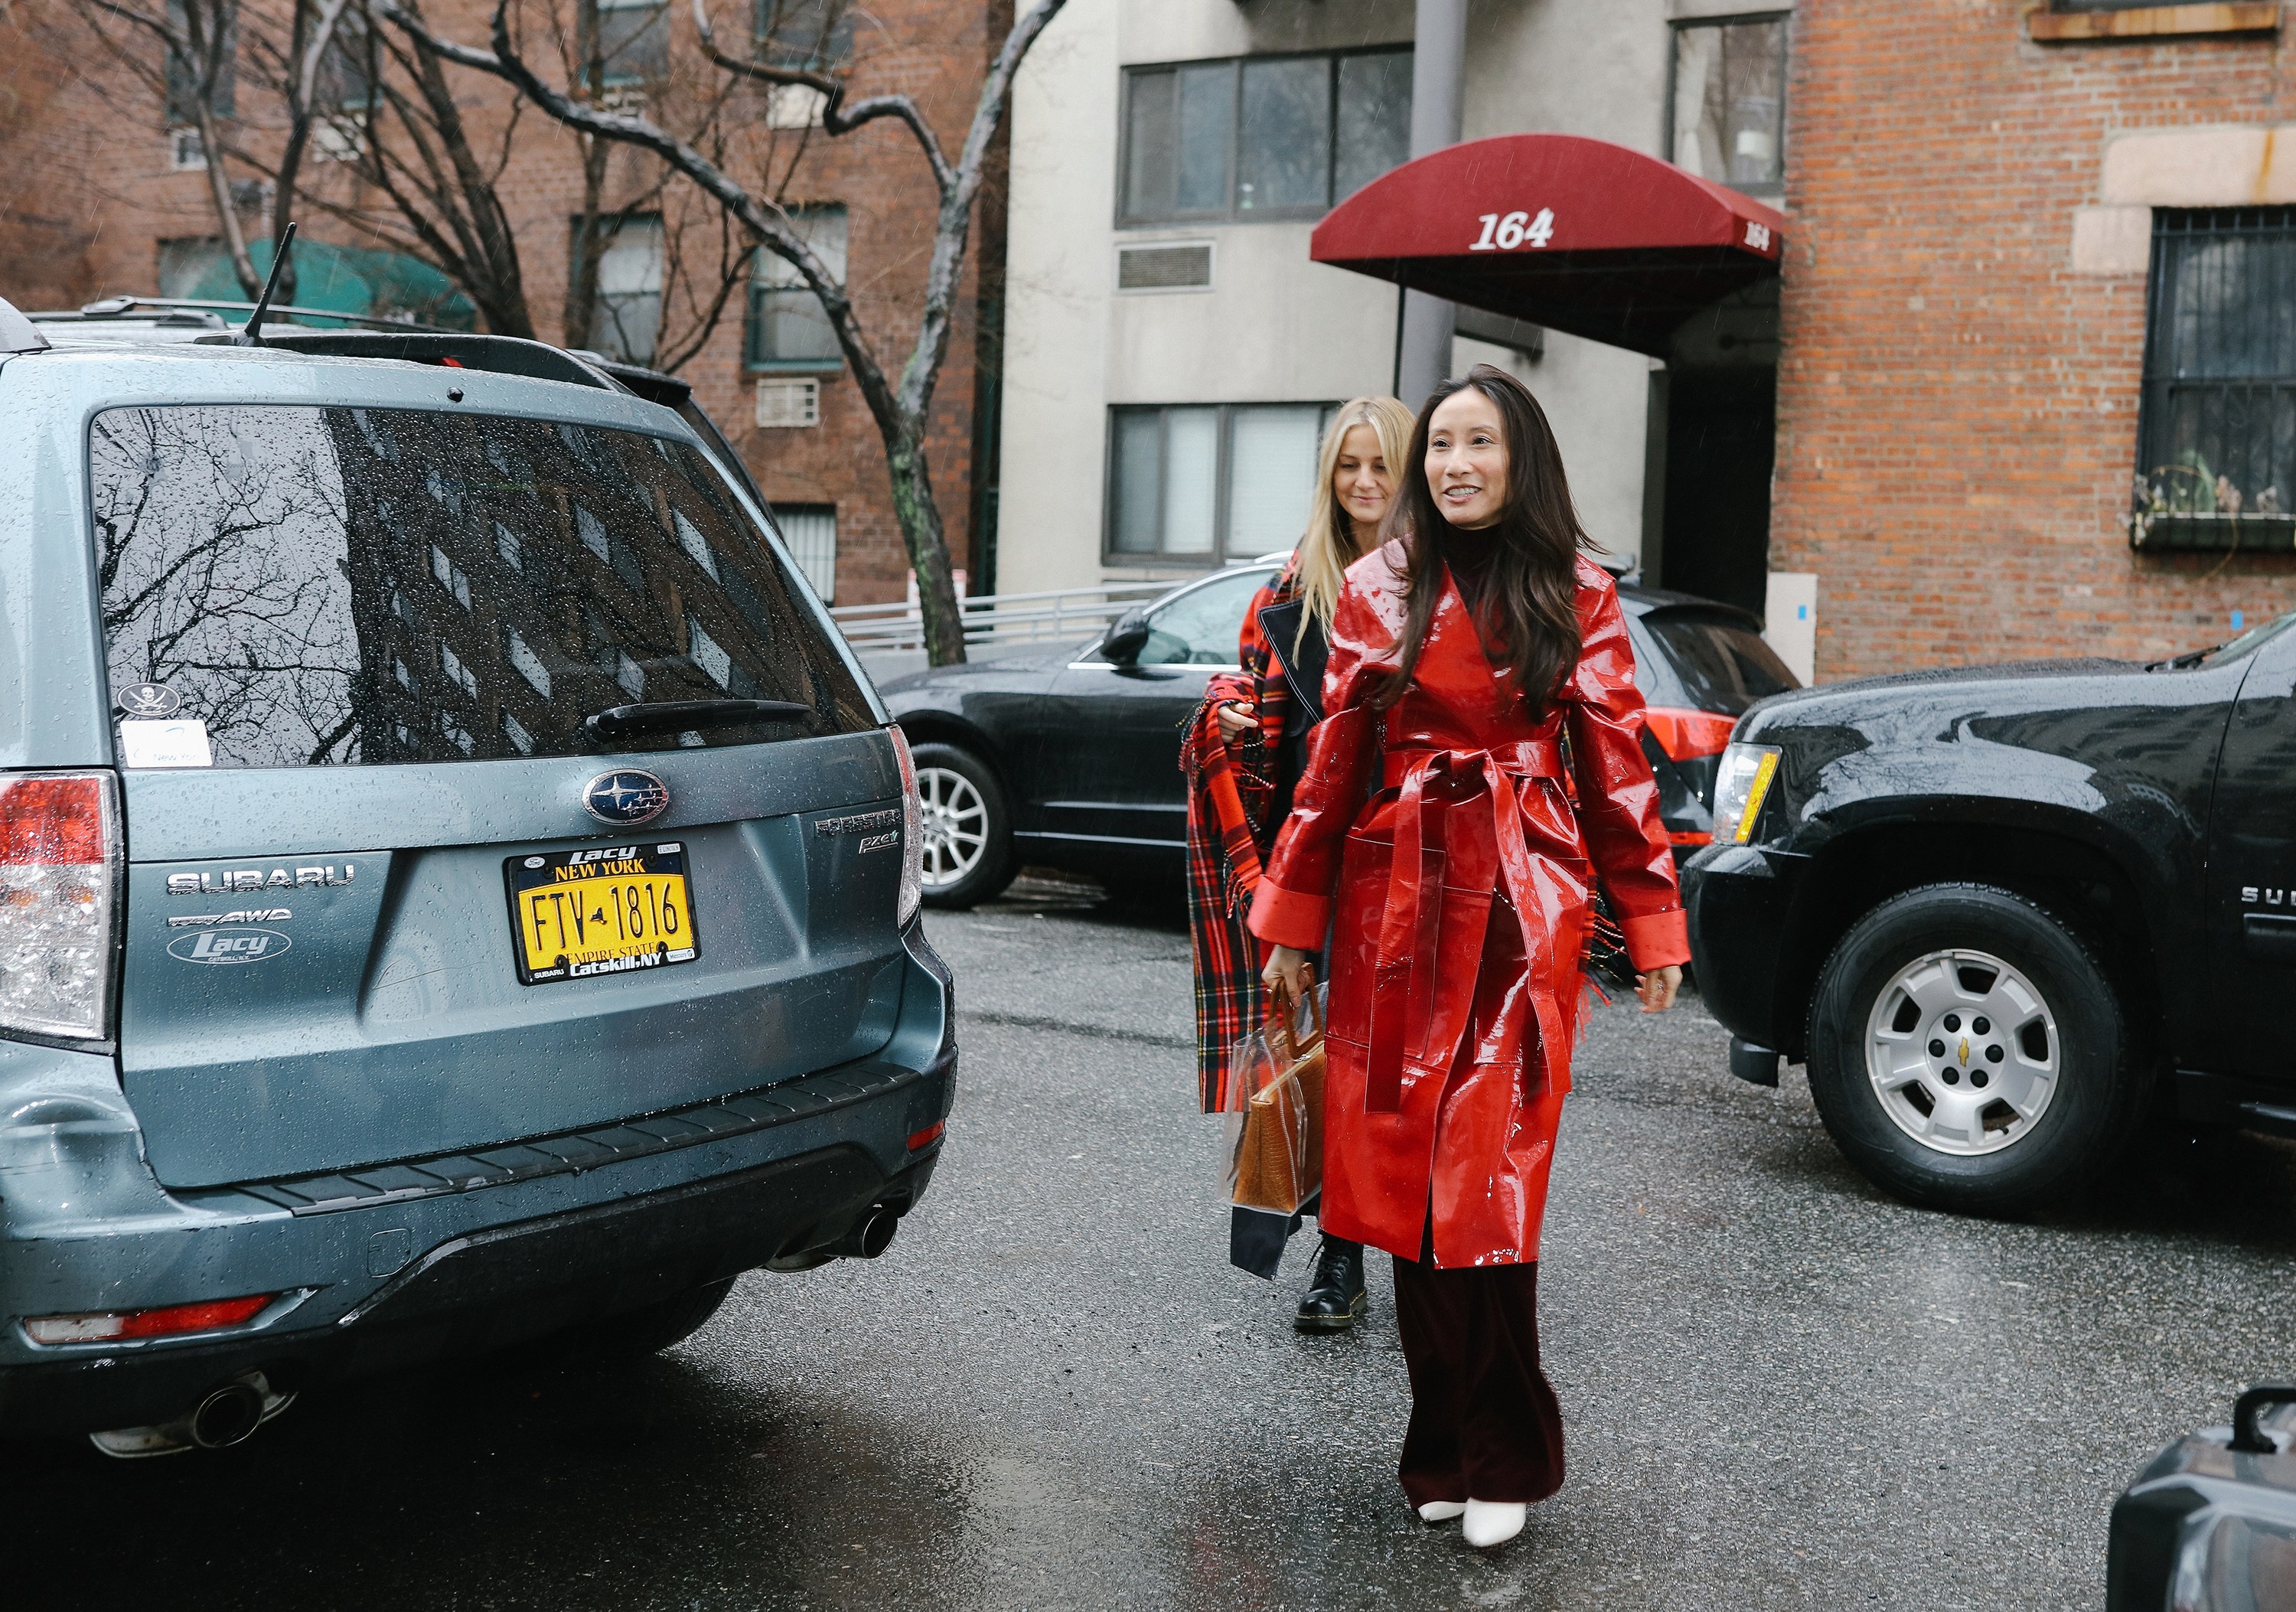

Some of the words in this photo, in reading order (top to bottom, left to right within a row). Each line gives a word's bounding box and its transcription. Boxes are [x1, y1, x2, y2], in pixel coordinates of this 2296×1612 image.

[1469, 207, 1554, 250] 164
[569, 846, 637, 865] Lacy
[166, 865, 354, 895] SUBARU
[555, 865, 596, 882] NEW
[601, 858, 646, 876] YORK
[190, 932, 269, 958] Lacy
[618, 941, 656, 958] STATE
[533, 967, 565, 980] SUBARU
